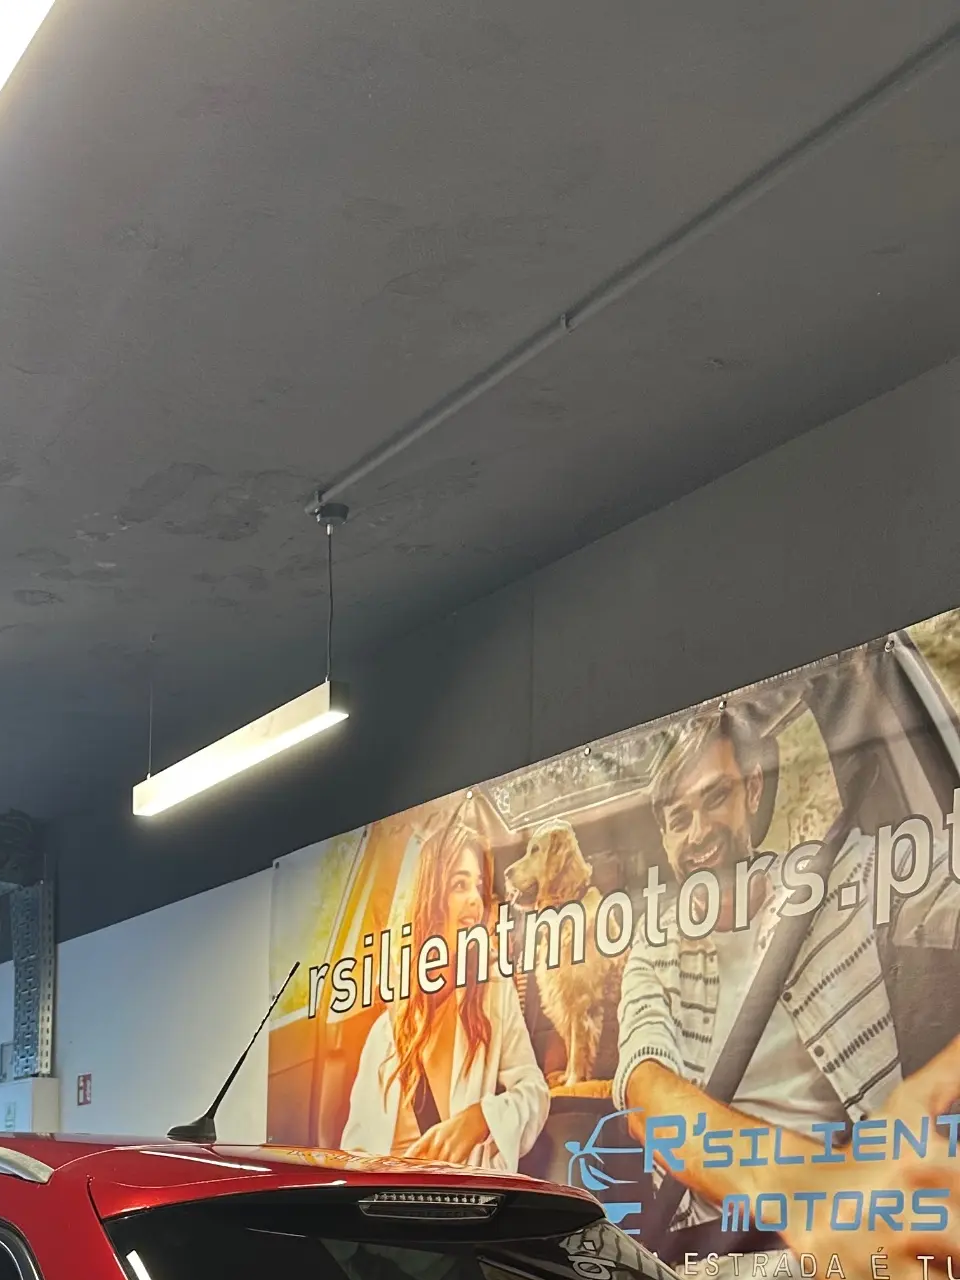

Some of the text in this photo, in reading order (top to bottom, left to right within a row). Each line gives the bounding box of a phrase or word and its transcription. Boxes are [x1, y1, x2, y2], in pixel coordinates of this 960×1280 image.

[720, 1188, 951, 1232] MOTORS
[683, 1251, 847, 1280] ESTRADA
[869, 1246, 891, 1280] É
